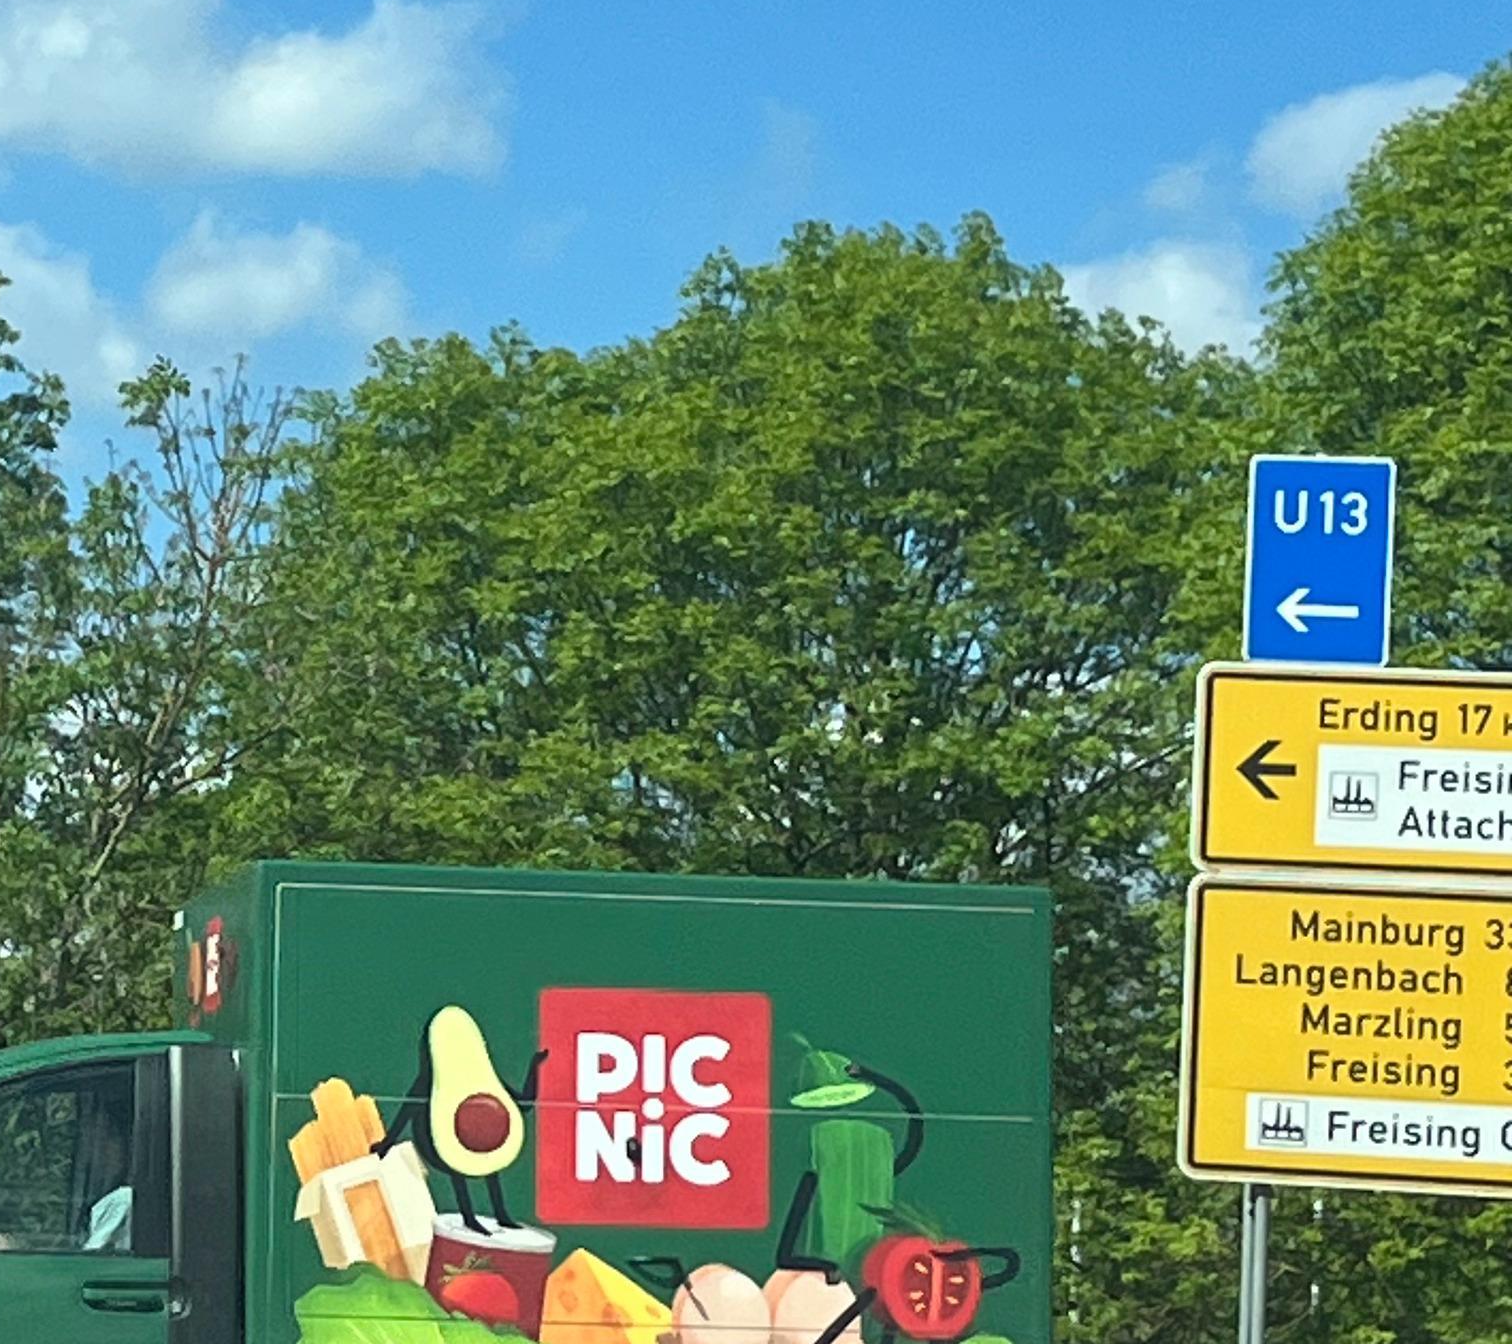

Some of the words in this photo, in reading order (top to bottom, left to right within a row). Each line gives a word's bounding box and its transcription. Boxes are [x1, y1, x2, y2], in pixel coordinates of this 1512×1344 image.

[1274, 489, 1368, 536] U13
[1318, 697, 1438, 742] Erding
[1457, 702, 1493, 736] 17
[1397, 759, 1512, 795] Freisi
[1290, 909, 1465, 957] Mainburg
[1484, 918, 1512, 951] 3
[1235, 953, 1464, 997] Langenbach
[1300, 1002, 1463, 1050] Marzling
[1306, 1049, 1461, 1096] Freising
[1327, 1110, 1481, 1158] Freising
